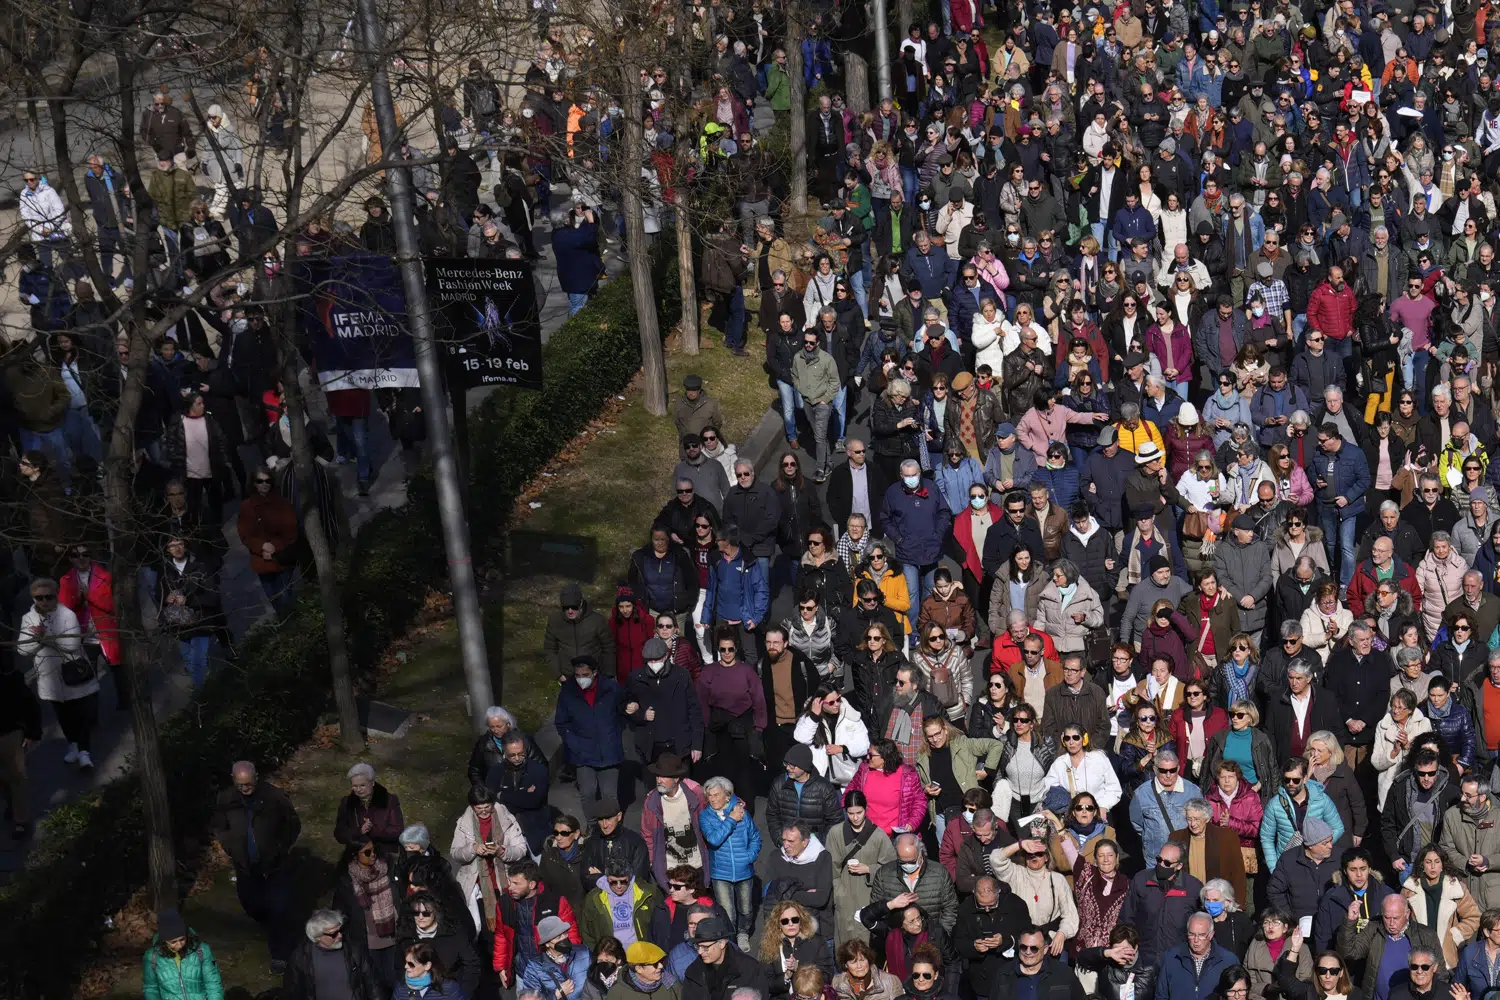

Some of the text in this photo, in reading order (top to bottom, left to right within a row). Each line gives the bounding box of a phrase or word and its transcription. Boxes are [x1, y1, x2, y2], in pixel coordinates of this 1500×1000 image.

[435, 267, 524, 280] Mercedes-Benz
[440, 292, 477, 301] MADRID
[333, 311, 384, 326] IFEMA
[337, 322, 400, 339] MADRID
[505, 357, 530, 371] feb
[358, 374, 398, 384] MADRID
[481, 375, 517, 384] ifema.es
